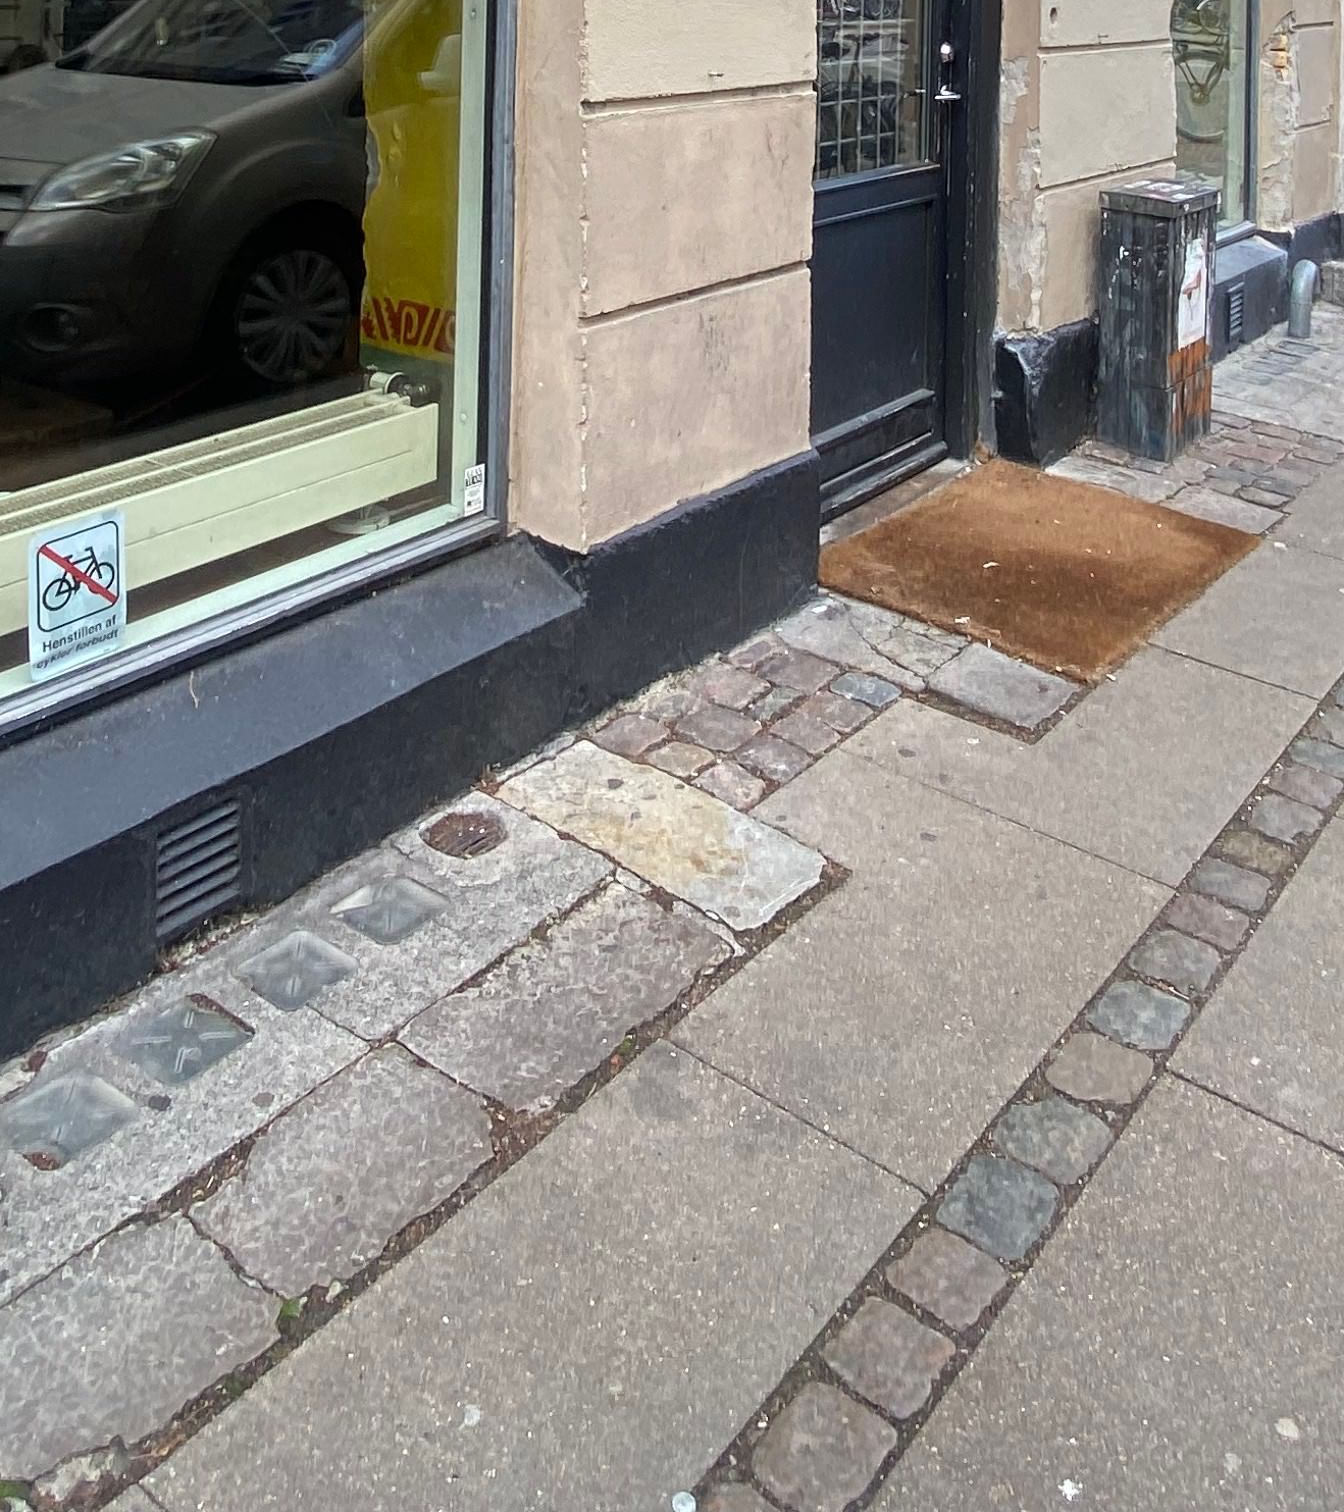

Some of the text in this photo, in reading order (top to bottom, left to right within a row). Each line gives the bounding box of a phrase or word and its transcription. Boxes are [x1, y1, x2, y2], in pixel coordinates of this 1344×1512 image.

[36, 629, 119, 669] cykler forbudt
[42, 614, 117, 653] Henstillen af
